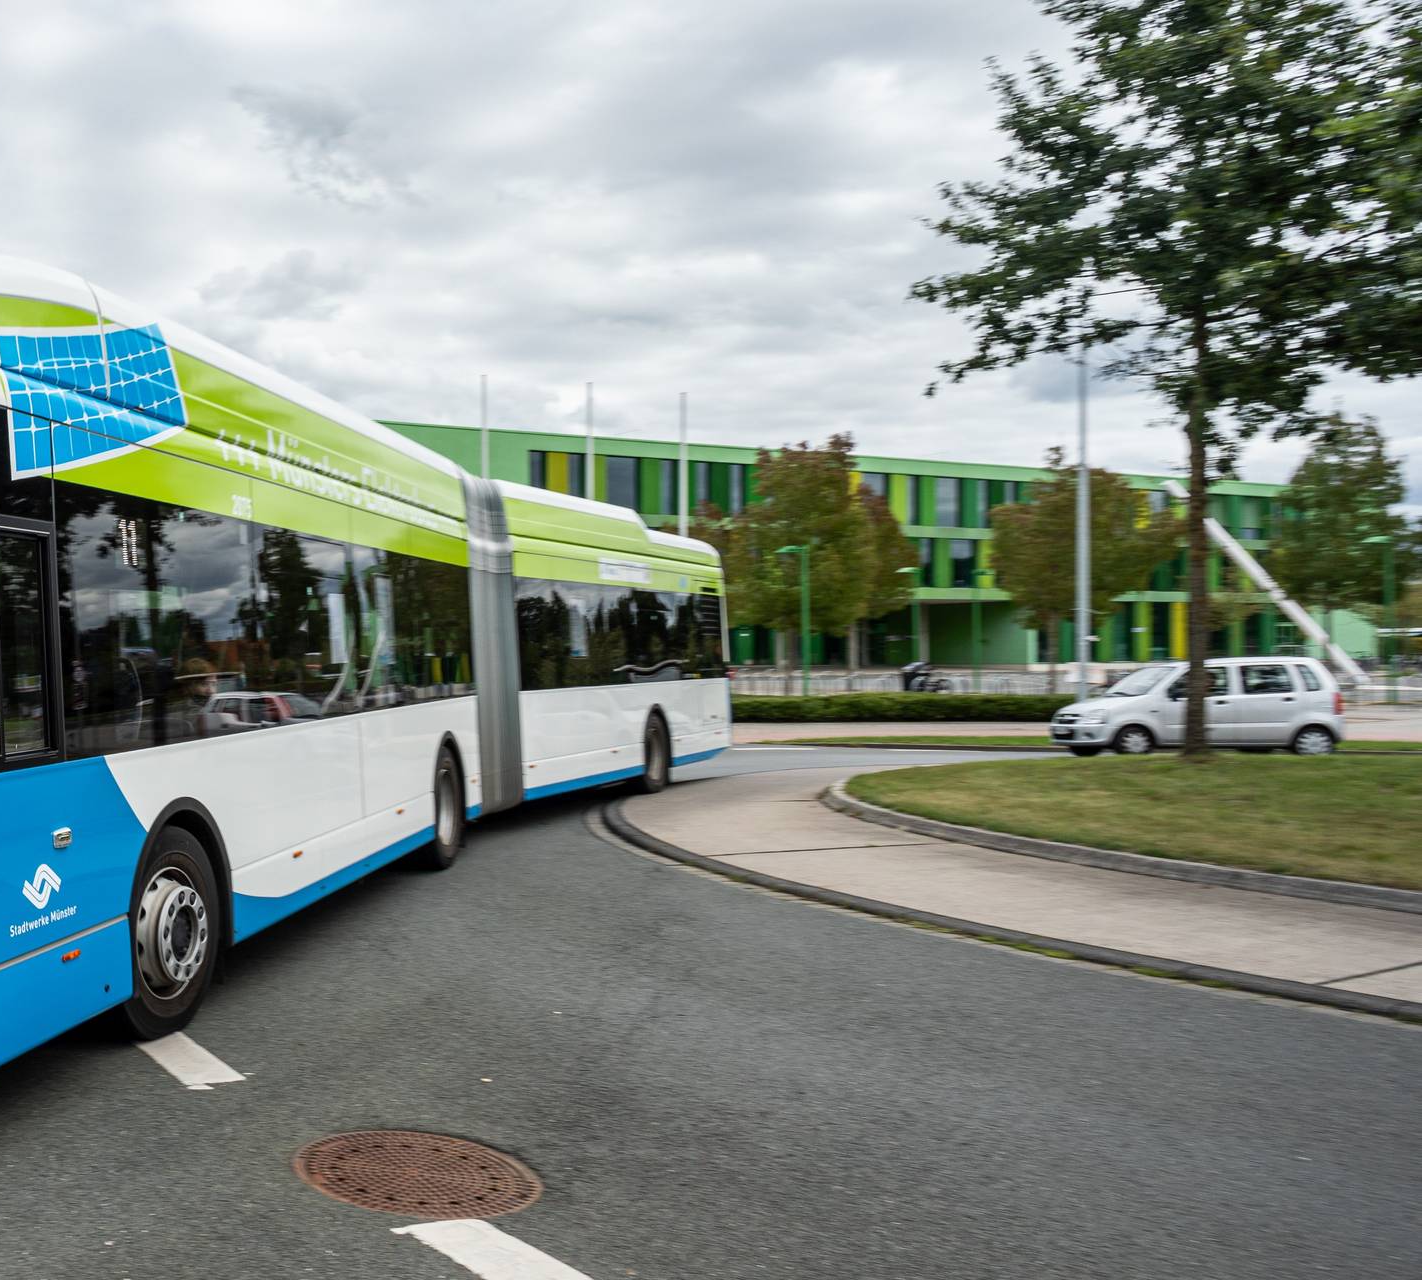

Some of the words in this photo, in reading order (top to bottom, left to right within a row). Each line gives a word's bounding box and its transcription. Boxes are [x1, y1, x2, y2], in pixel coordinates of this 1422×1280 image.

[118, 519, 138, 566] 11
[9, 915, 50, 938] Stadtwerke
[50, 905, 77, 924] Münster
